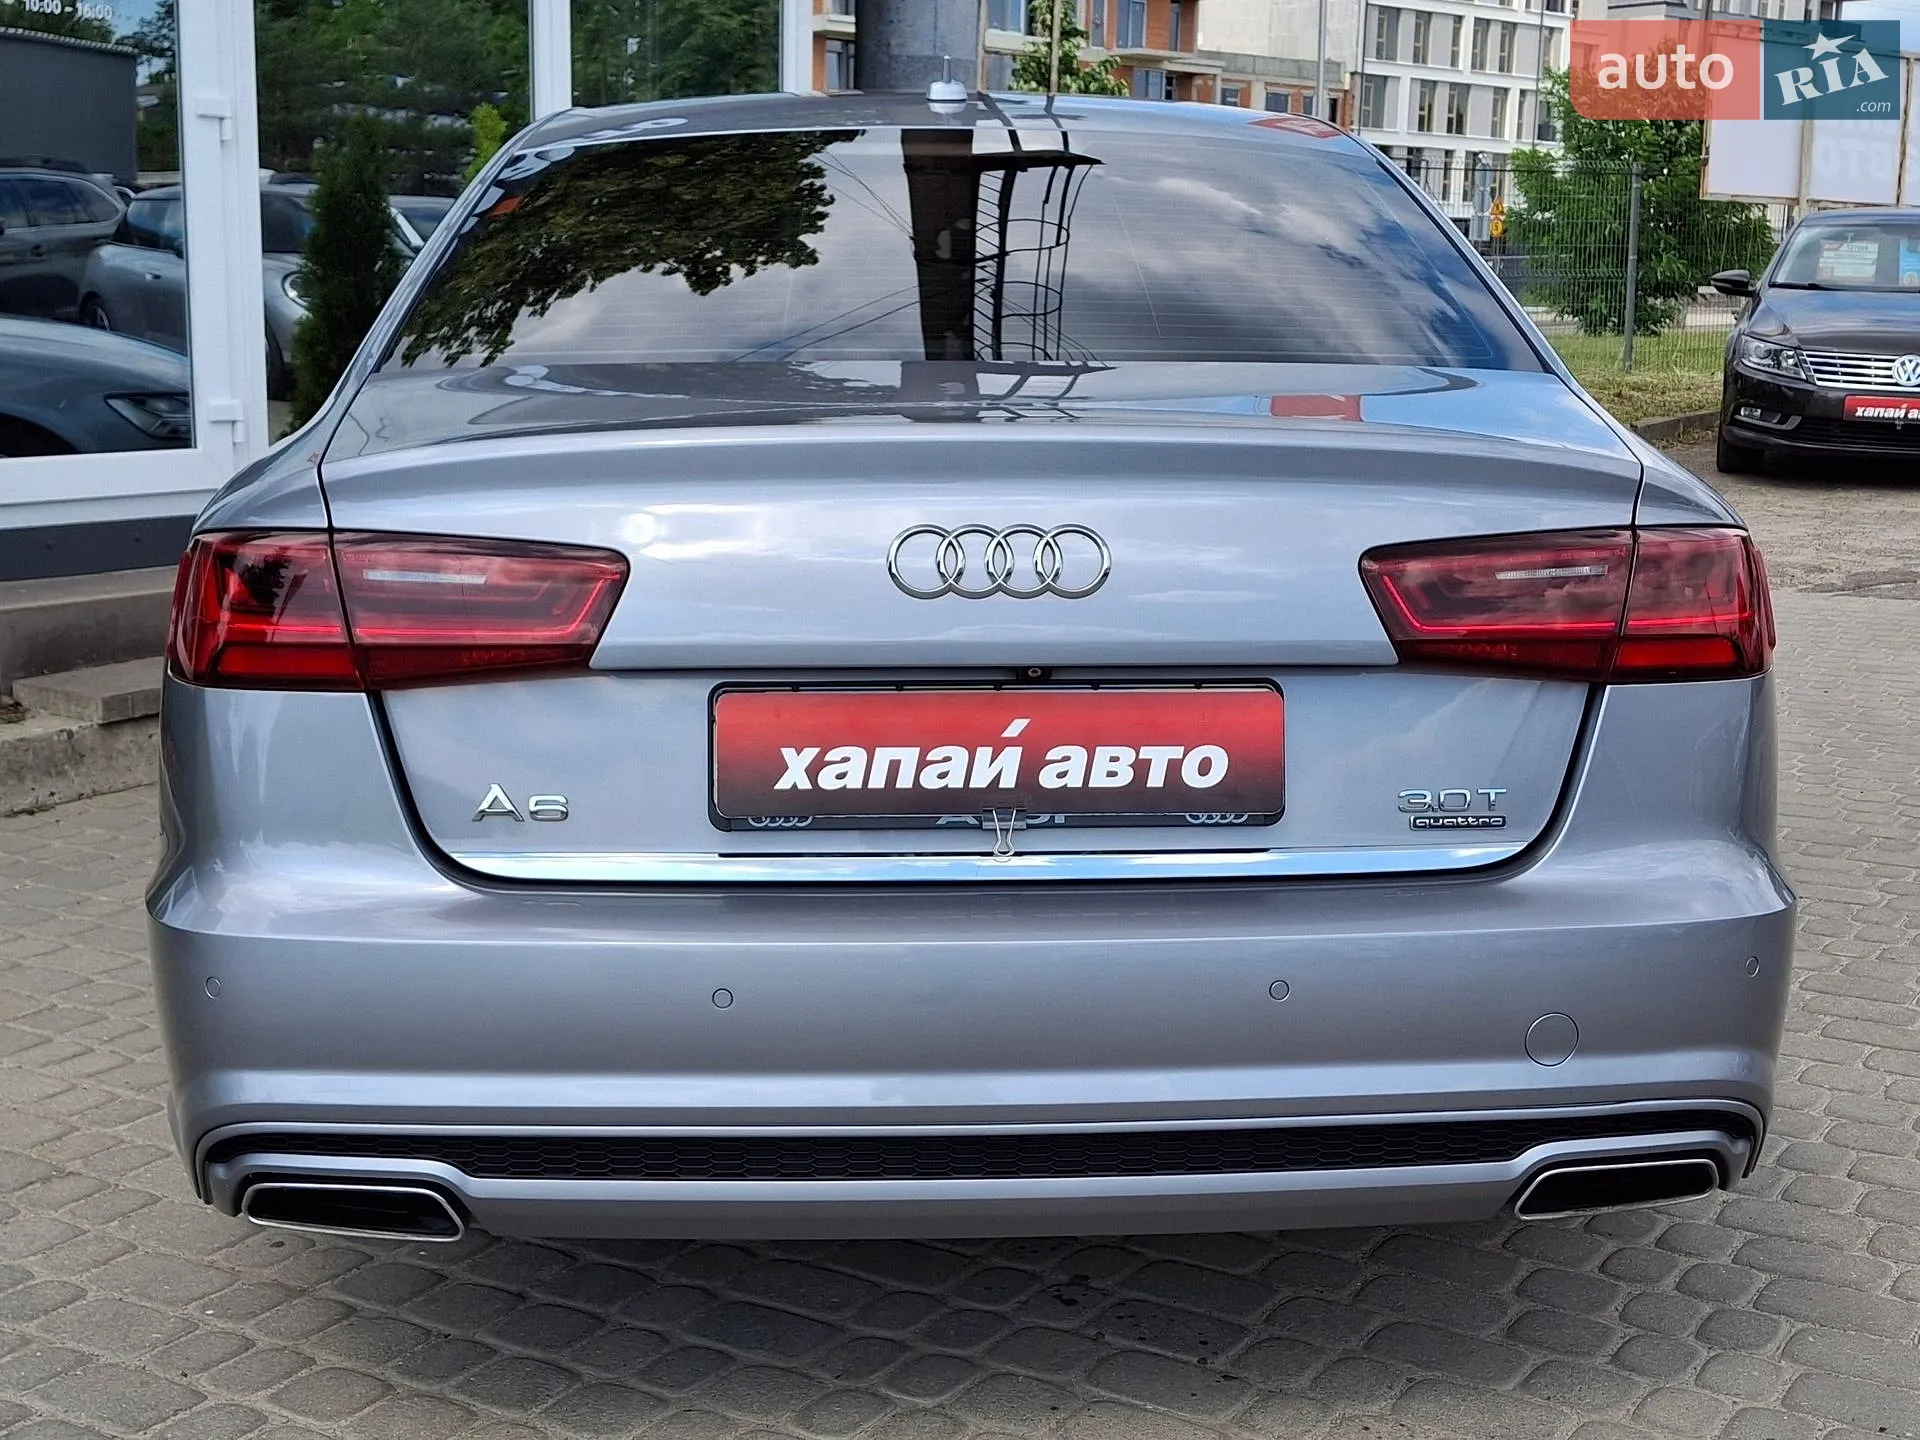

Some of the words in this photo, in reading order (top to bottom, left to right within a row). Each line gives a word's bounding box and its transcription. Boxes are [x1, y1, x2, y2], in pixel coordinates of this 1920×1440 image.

[25, 0, 61, 14] 10:00
[76, 3, 113, 19] 16:00
[1855, 403, 1907, 419] хапай
[1908, 408, 1920, 419] а
[774, 718, 1031, 790] хапай
[1038, 744, 1229, 789] авто
[472, 783, 568, 822] A6
[1415, 816, 1503, 828] quattro
